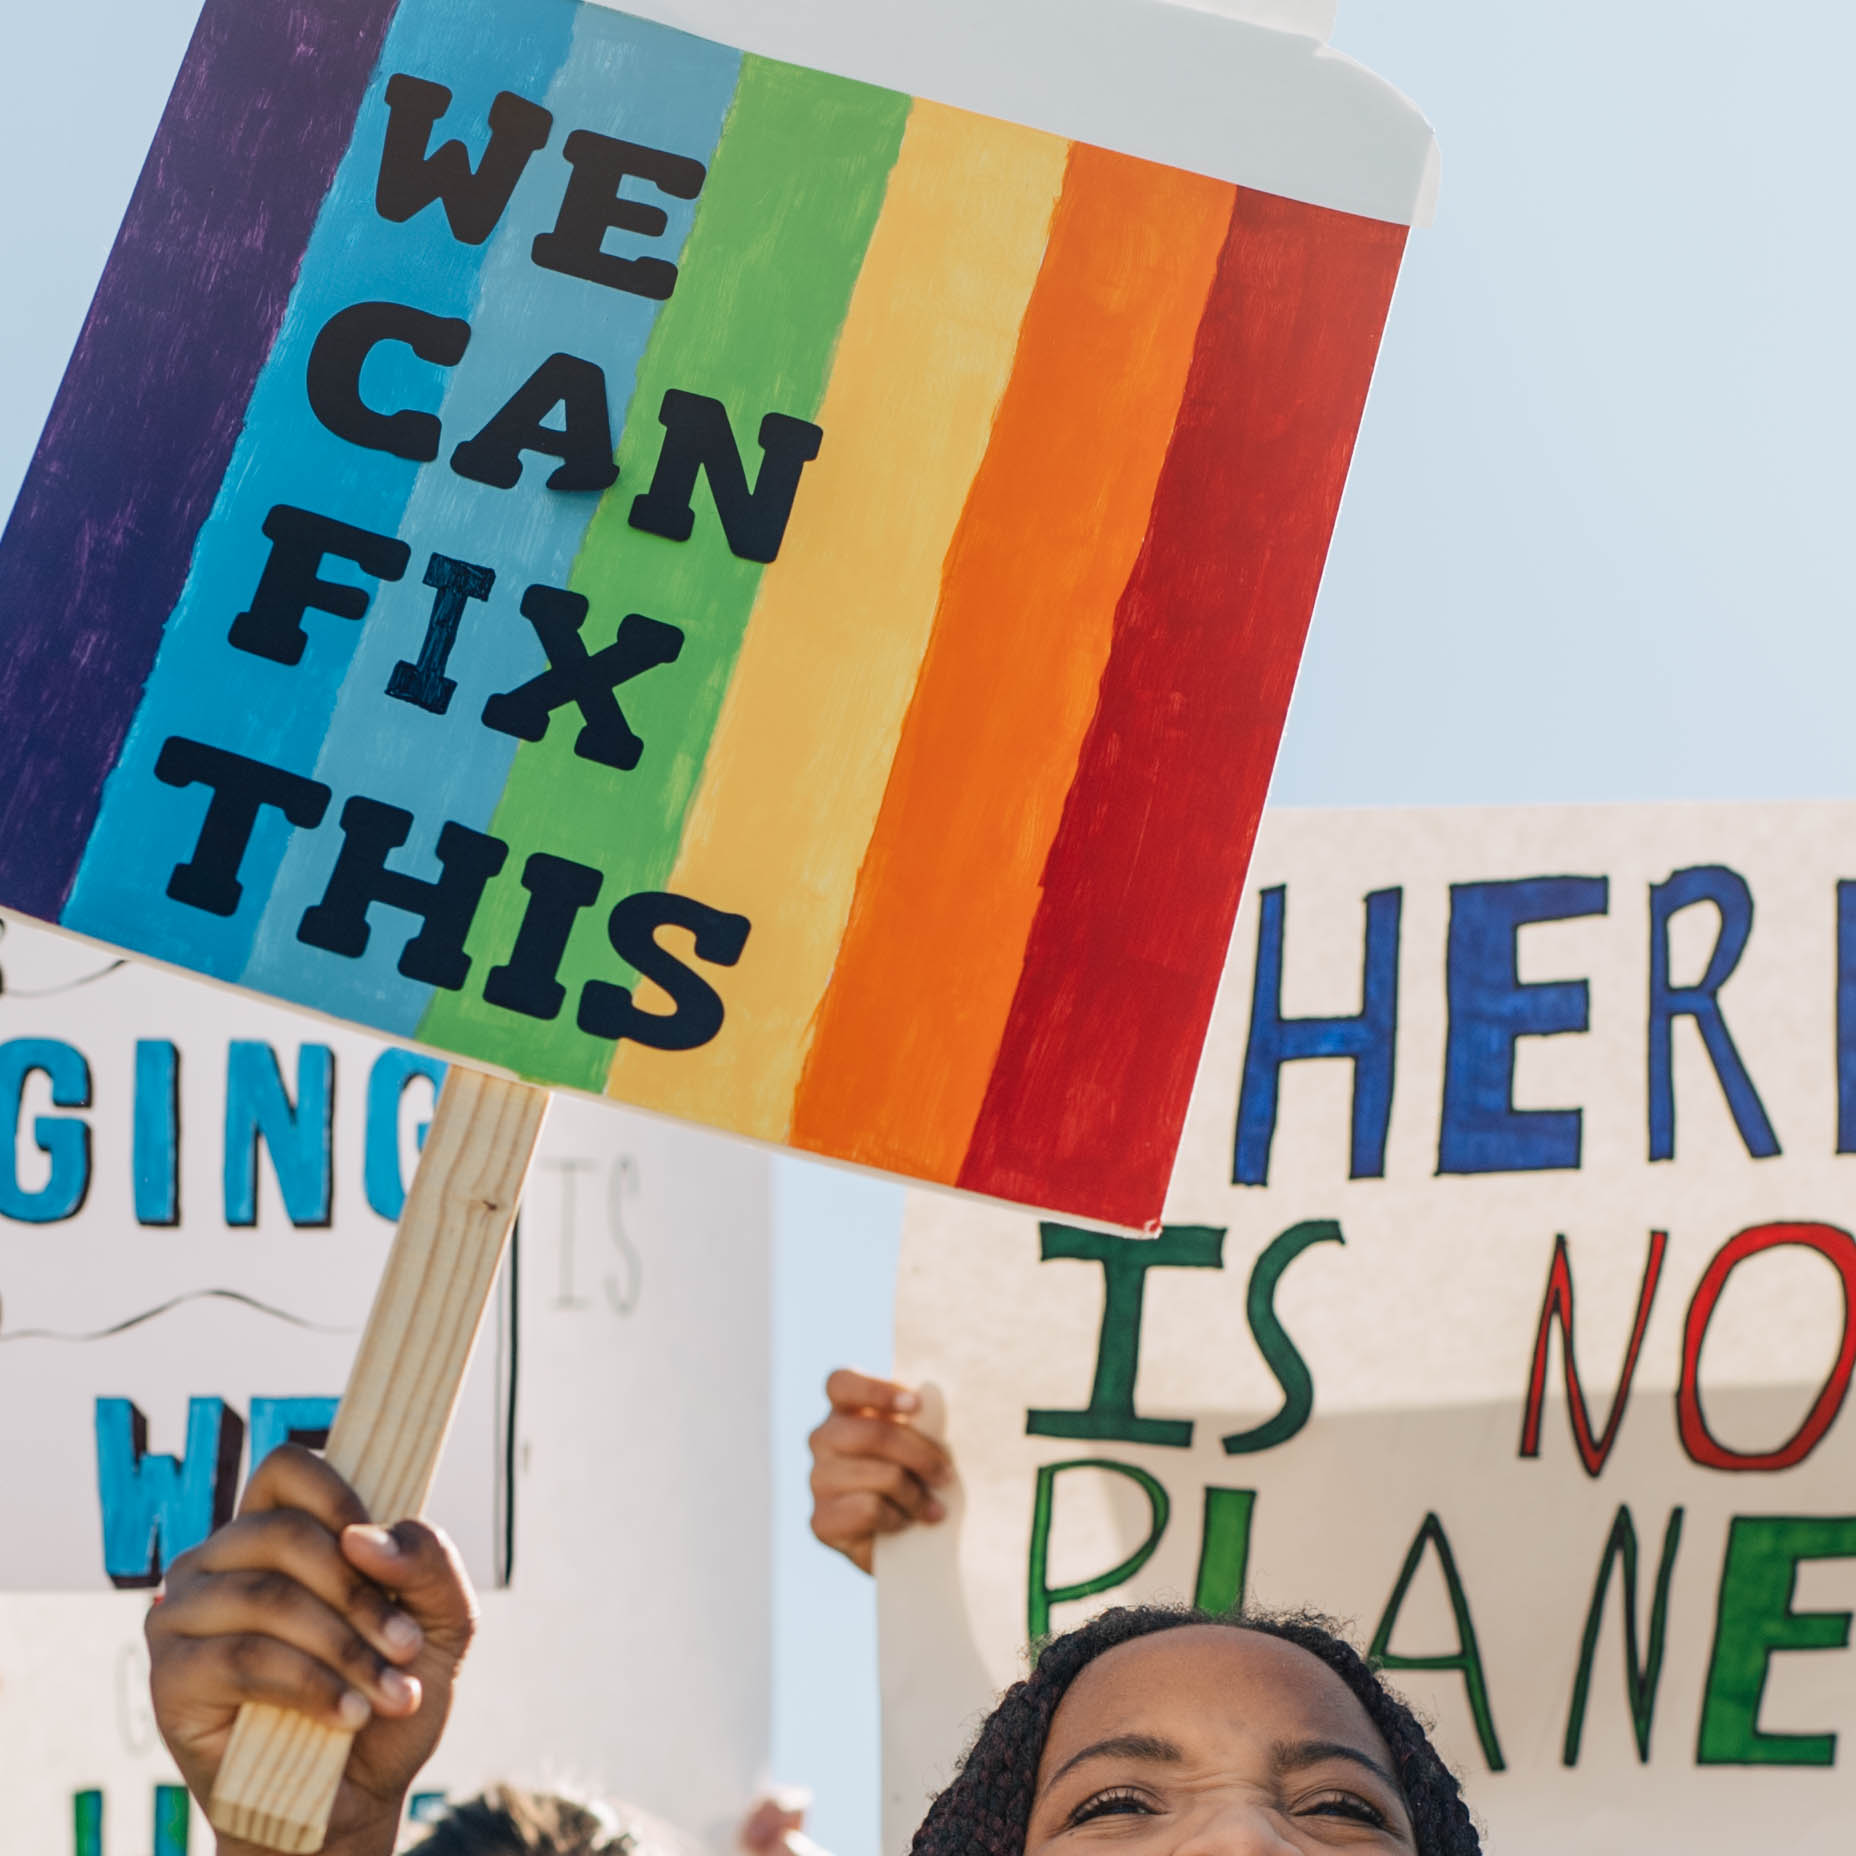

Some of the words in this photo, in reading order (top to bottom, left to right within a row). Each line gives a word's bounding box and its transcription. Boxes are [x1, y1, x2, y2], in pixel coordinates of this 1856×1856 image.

[375, 72, 707, 301] WE
[306, 300, 824, 564] CAN
[227, 503, 685, 771] FIX
[152, 735, 752, 1052] THIS
[1026, 1220, 1343, 1456] IS
